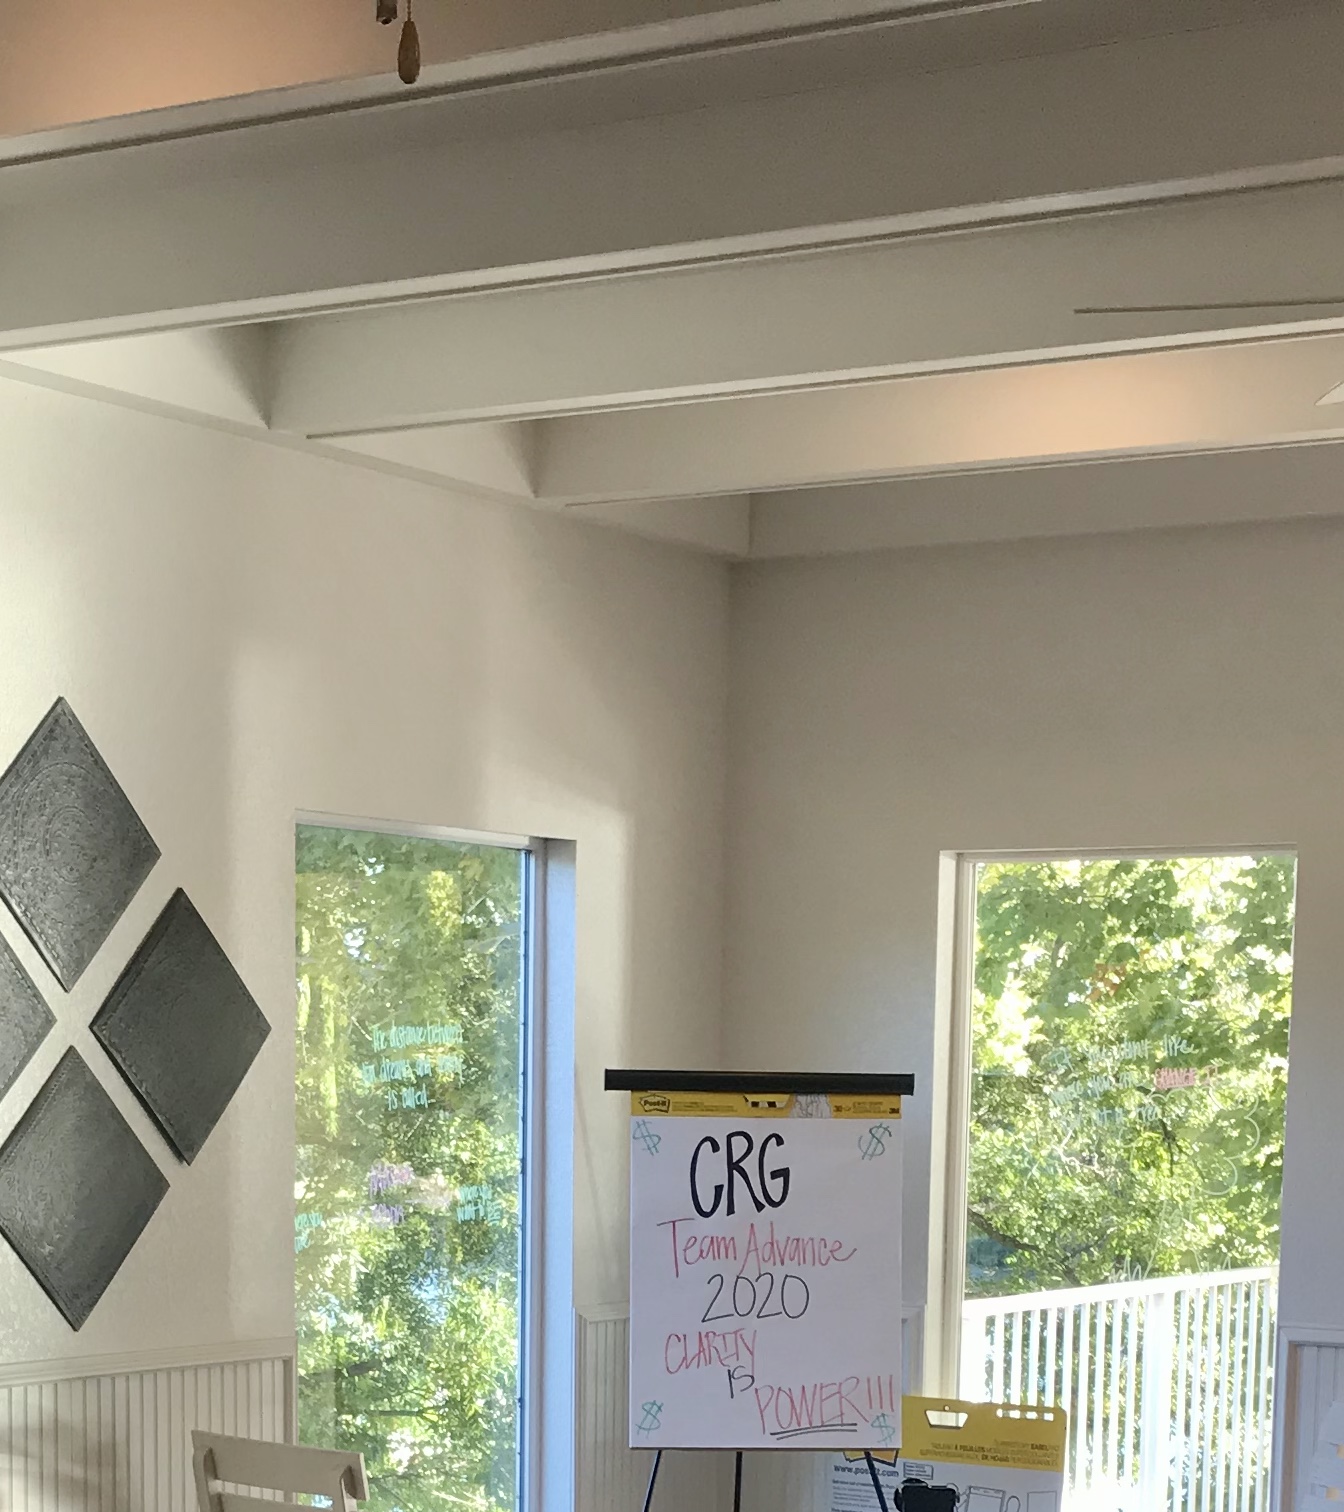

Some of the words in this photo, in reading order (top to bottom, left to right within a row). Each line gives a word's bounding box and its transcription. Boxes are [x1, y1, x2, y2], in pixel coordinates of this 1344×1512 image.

[689, 1130, 791, 1218] CRG
[657, 1217, 738, 1278] Team
[739, 1221, 858, 1276] Advance
[701, 1272, 810, 1323] 2020
[664, 1328, 757, 1375] CLARITY
